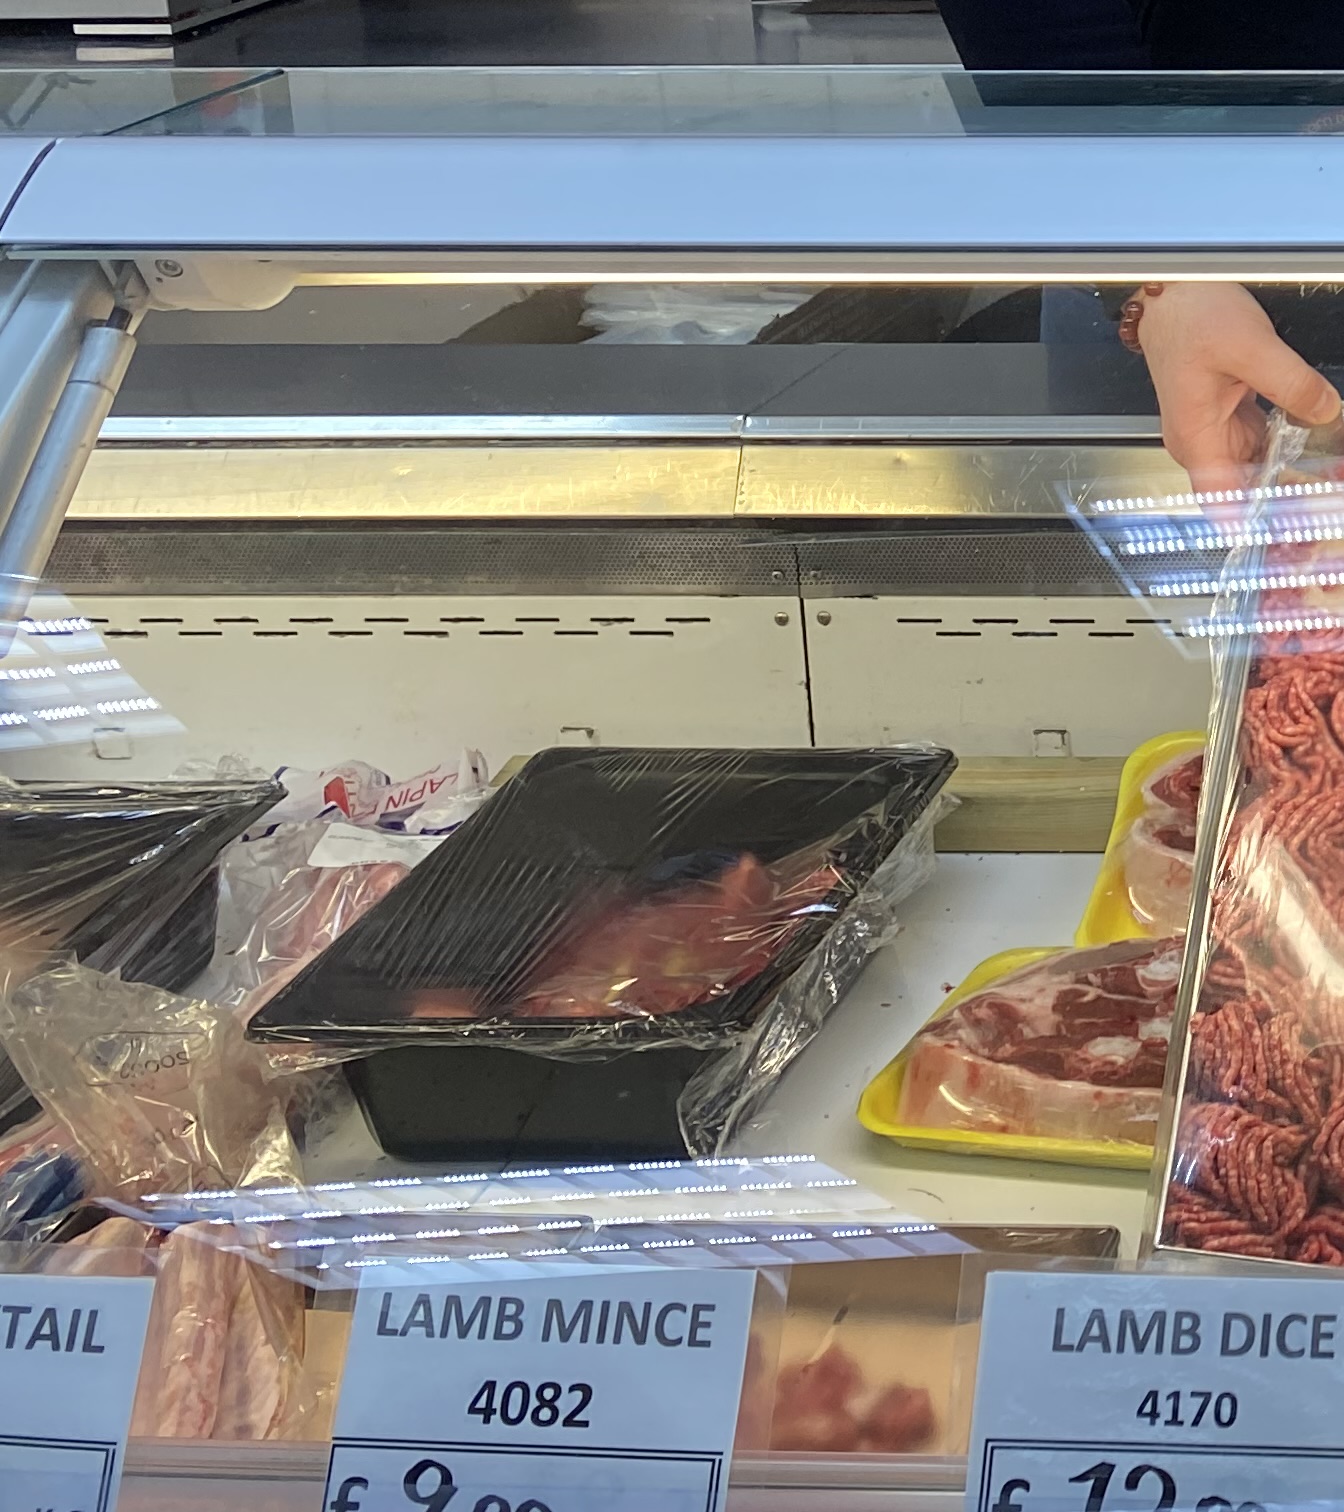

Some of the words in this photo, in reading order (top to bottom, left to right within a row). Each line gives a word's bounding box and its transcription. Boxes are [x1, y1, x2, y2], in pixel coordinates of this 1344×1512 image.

[2, 1305, 105, 1354] TAIL
[376, 1291, 526, 1342] LAMB
[541, 1299, 716, 1349] MINCE
[1052, 1307, 1201, 1356] LAMB
[1220, 1312, 1338, 1359] DICE
[467, 1380, 594, 1428] 4082
[1136, 1390, 1239, 1429] 4170
